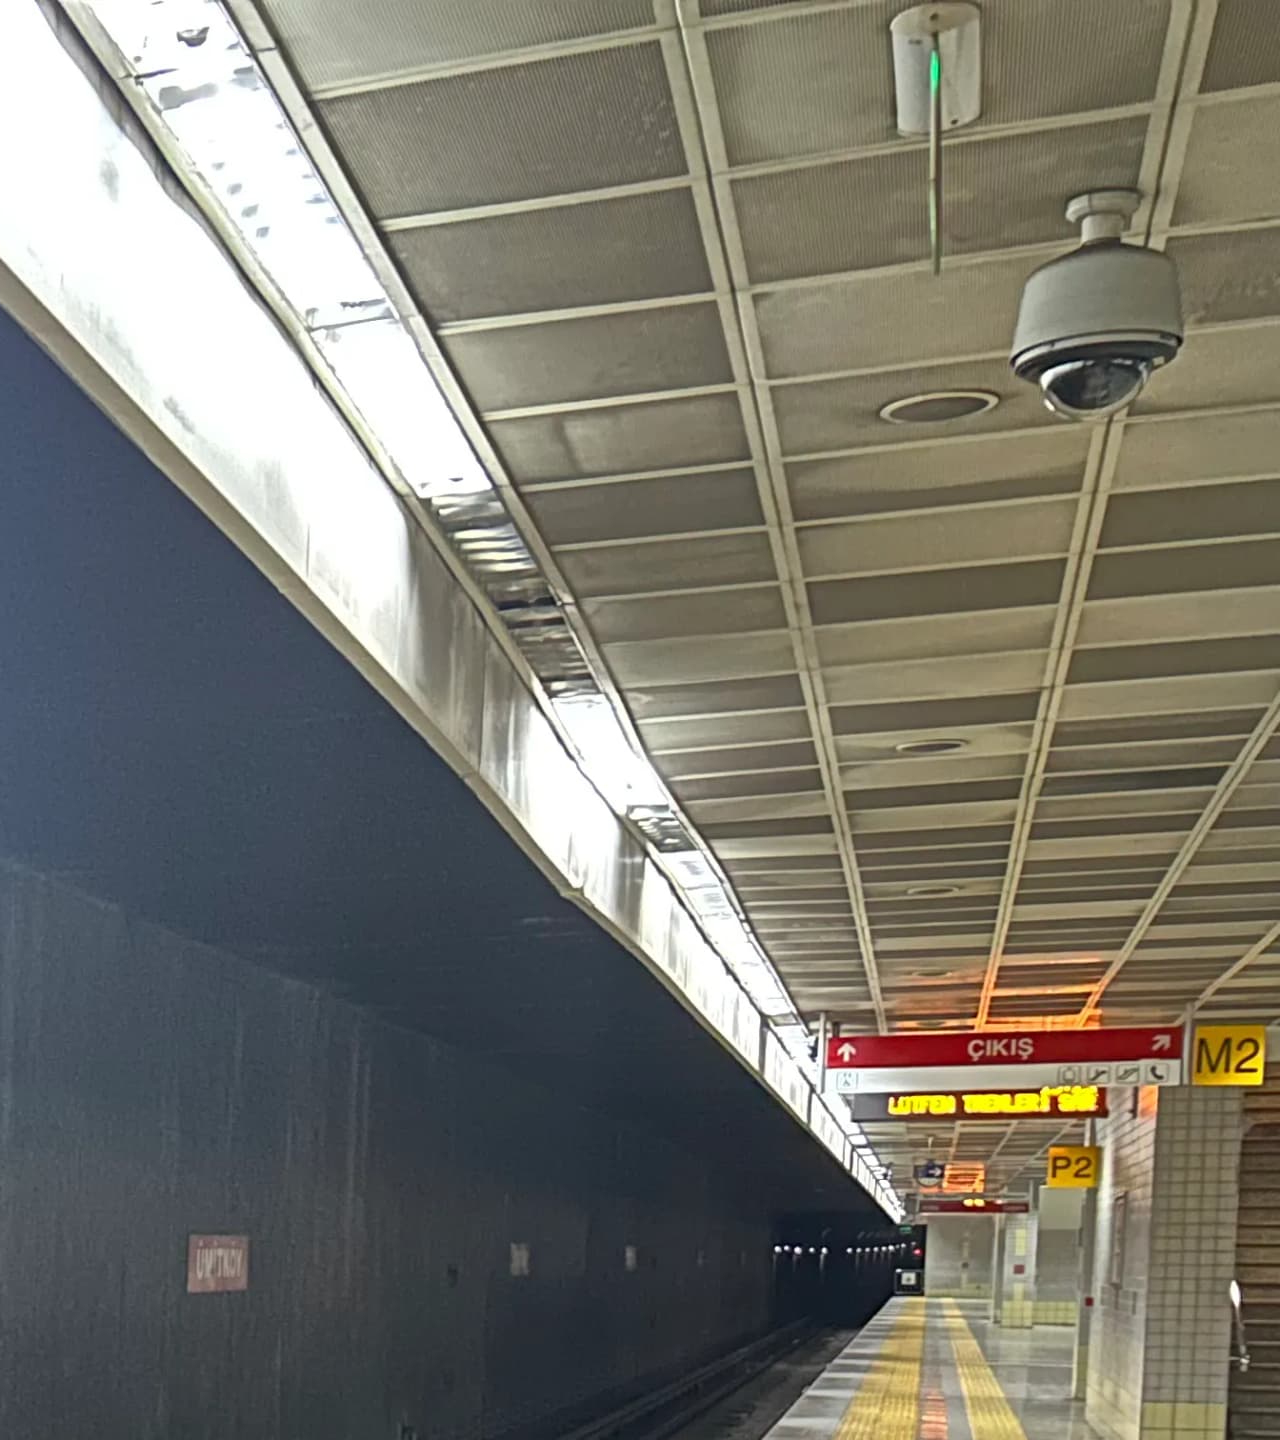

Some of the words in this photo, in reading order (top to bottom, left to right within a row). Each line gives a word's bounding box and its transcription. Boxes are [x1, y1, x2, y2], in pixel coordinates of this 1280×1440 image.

[967, 1038, 1034, 1061] ÇIKIŞ
[1197, 1037, 1259, 1073] M2
[1051, 1156, 1092, 1178] P2
